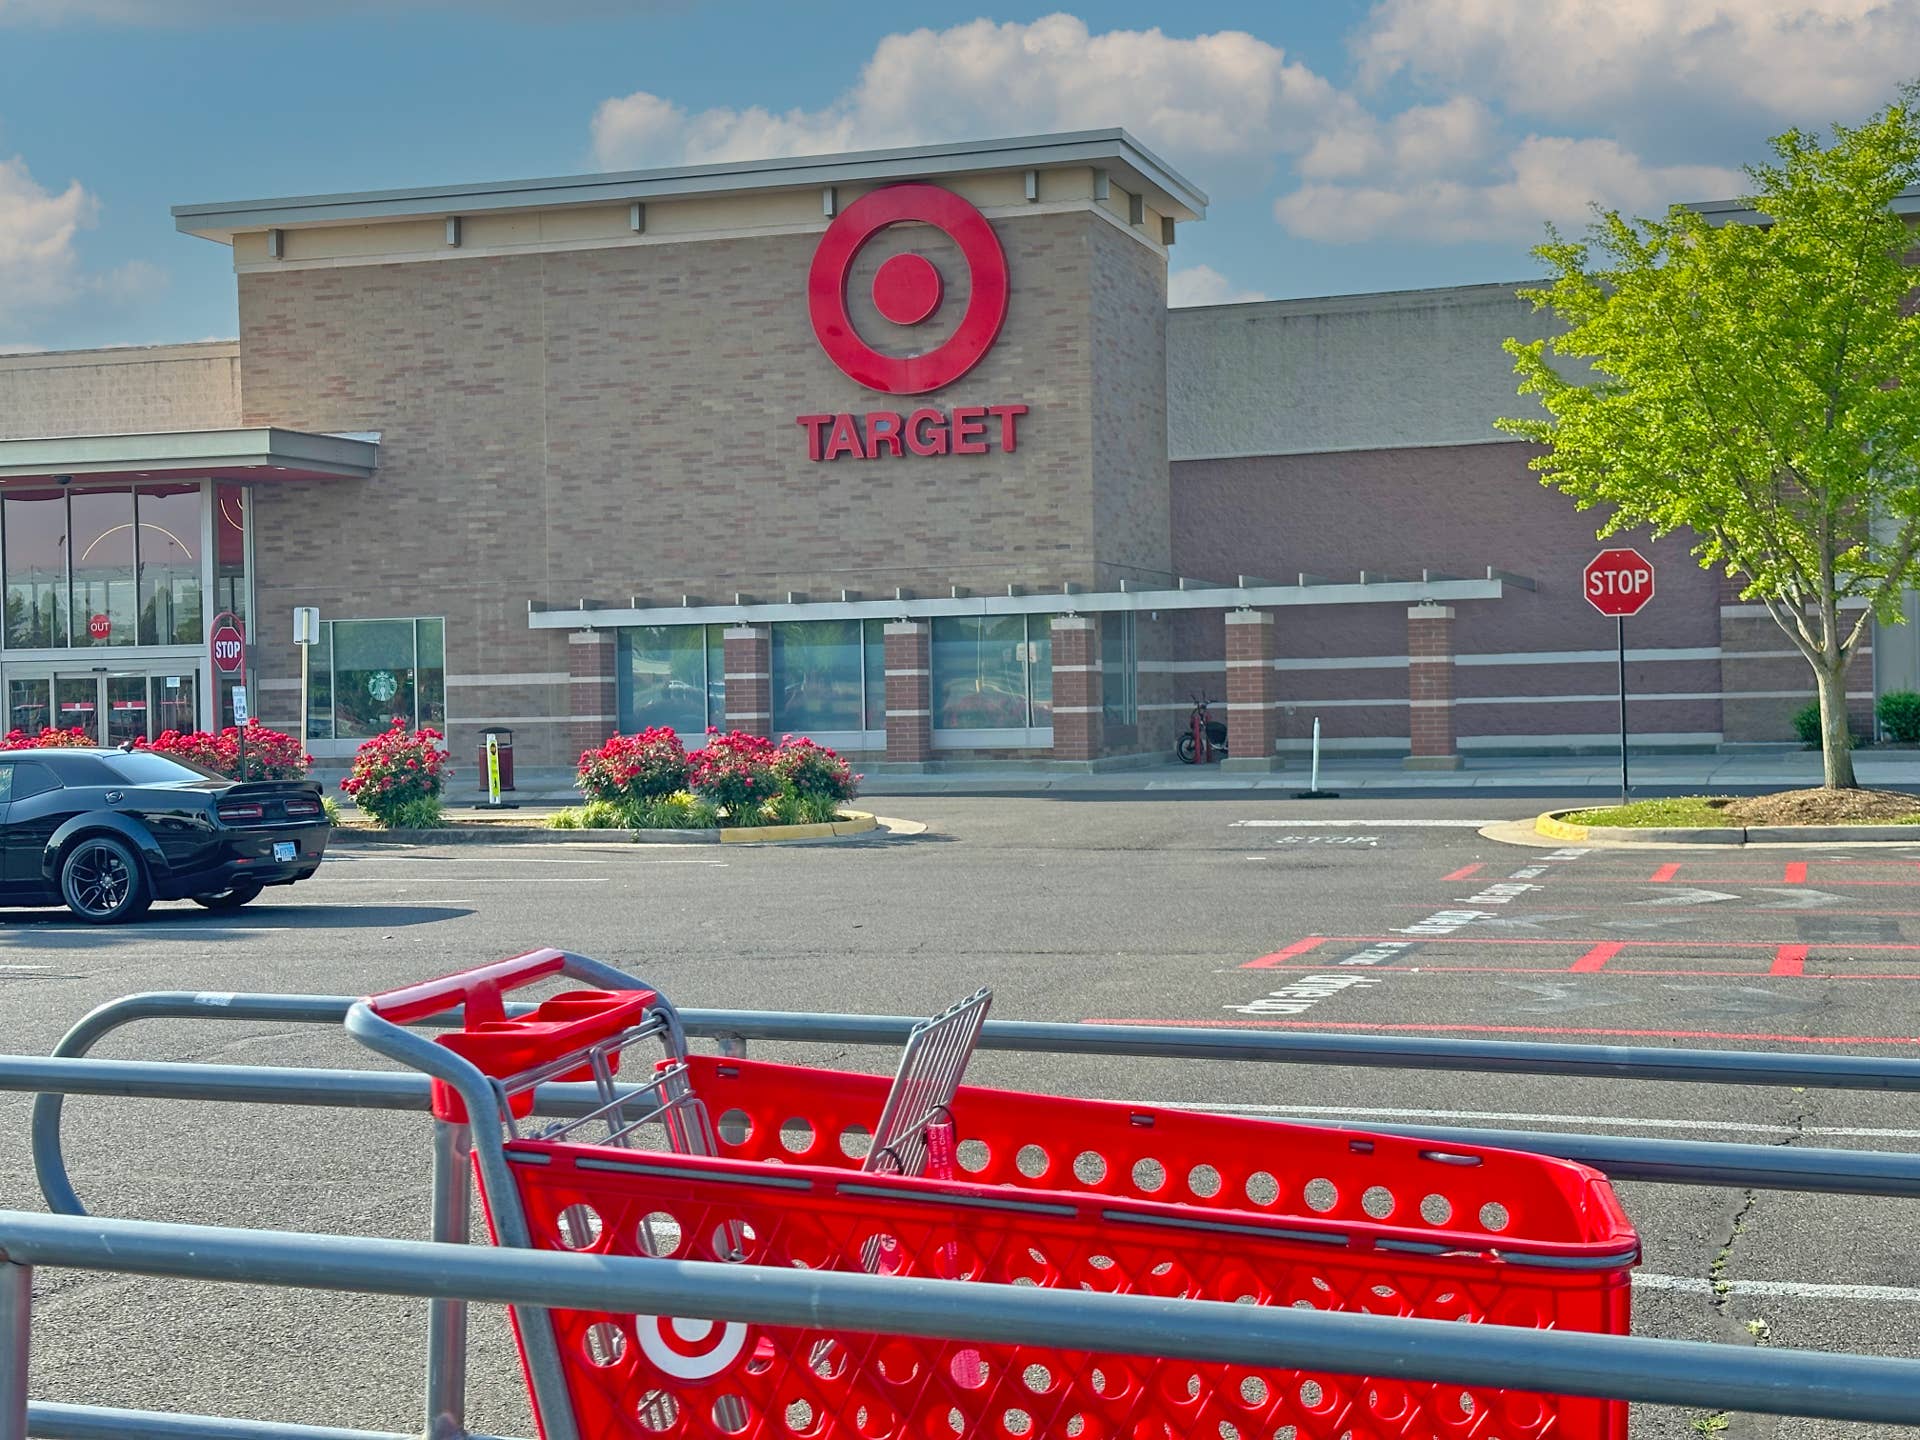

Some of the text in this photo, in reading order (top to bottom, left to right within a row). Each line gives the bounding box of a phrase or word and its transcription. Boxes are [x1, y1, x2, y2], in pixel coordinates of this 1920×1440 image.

[796, 404, 1029, 461] TARGET
[1589, 569, 1649, 595] STOP
[90, 622, 110, 632] OUT
[215, 640, 241, 659] STOP
[1276, 836, 1379, 844] STOP
[1388, 910, 1498, 934] drive up
[1222, 974, 1382, 1014] drive up
